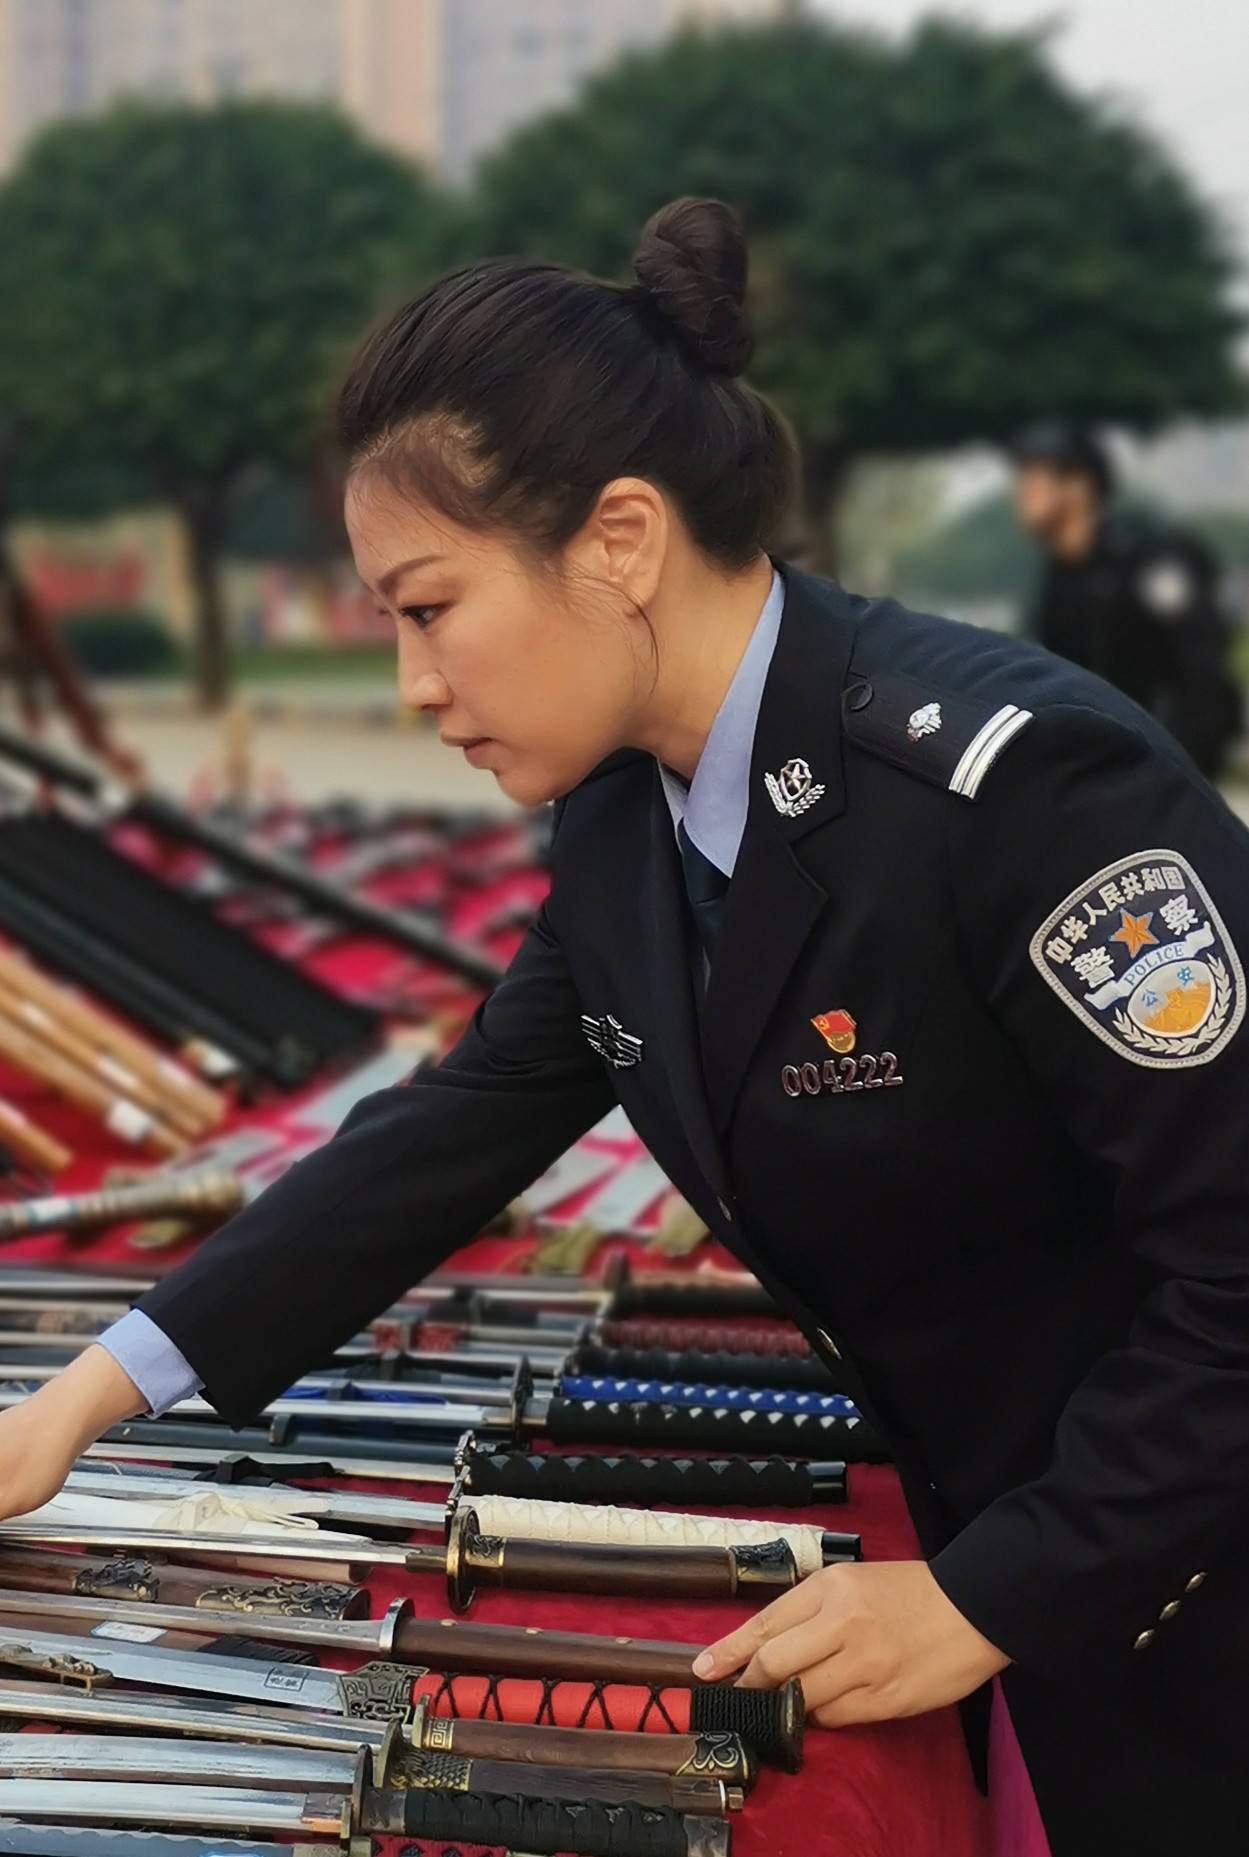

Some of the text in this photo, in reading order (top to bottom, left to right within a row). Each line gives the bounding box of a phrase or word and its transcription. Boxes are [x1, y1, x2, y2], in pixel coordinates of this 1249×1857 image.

[1045, 866, 1186, 964] 中华人民共和国
[1125, 943, 1185, 987] POLICE
[781, 1051, 904, 1097] 004222
